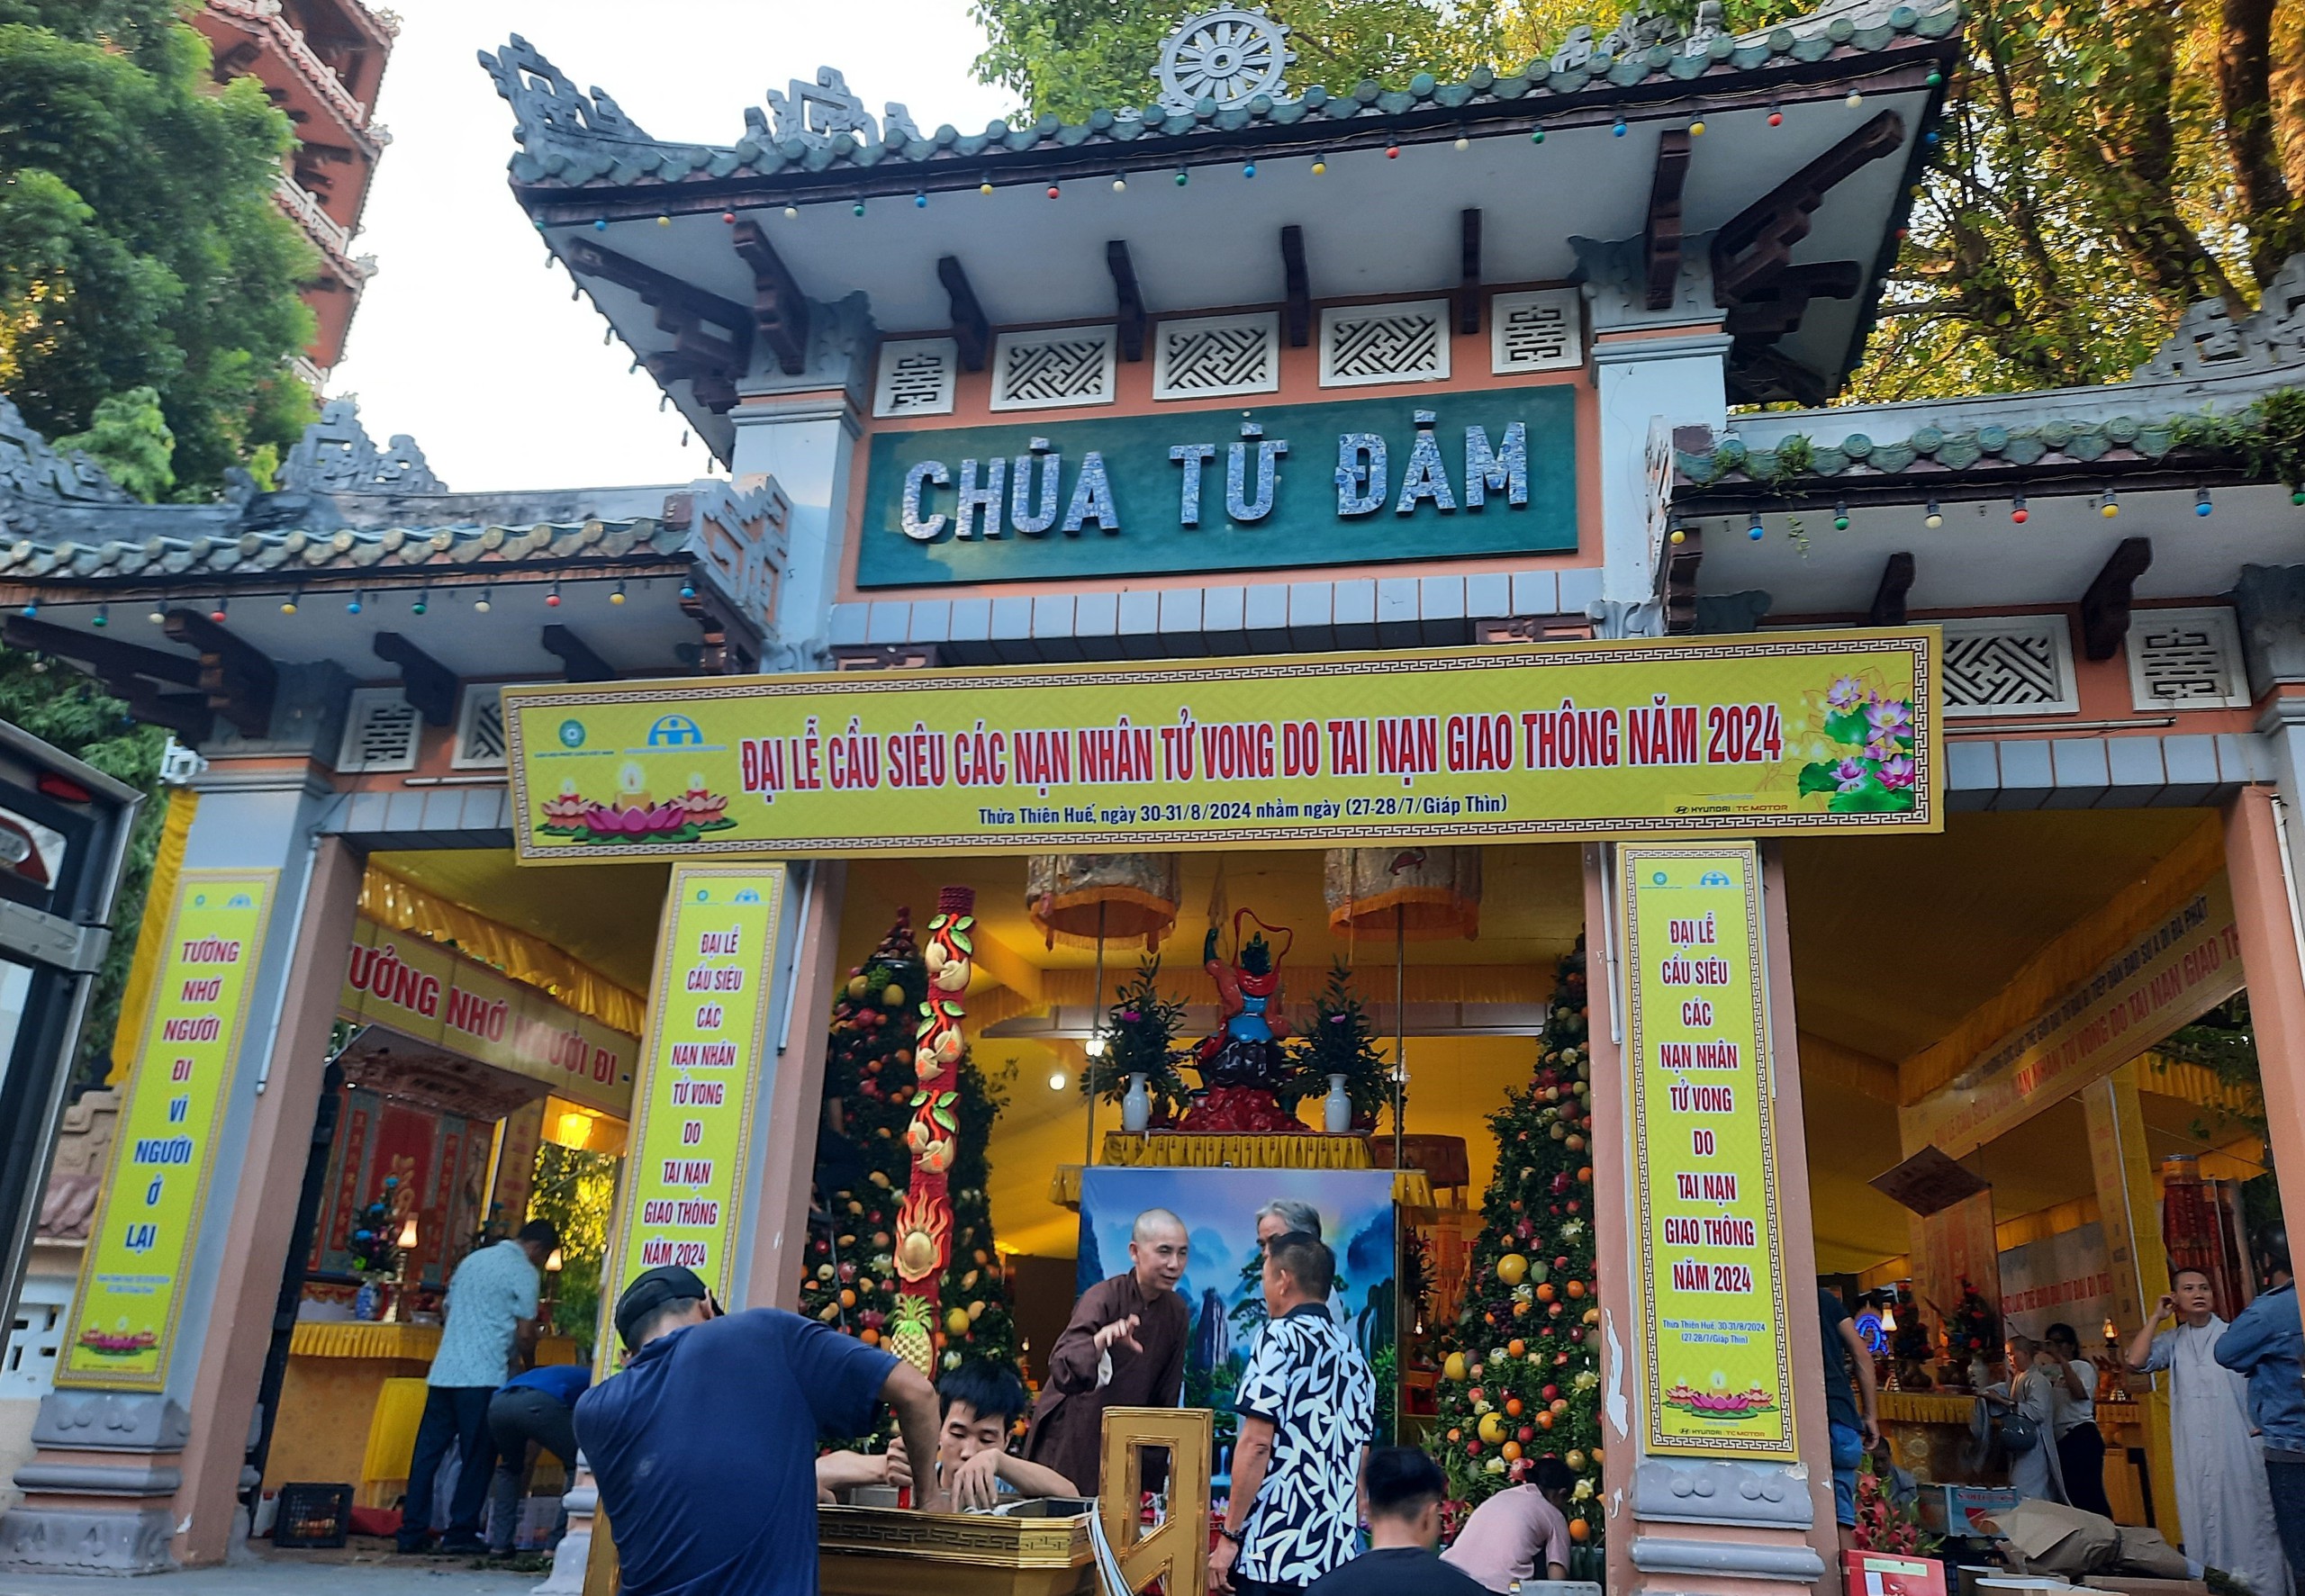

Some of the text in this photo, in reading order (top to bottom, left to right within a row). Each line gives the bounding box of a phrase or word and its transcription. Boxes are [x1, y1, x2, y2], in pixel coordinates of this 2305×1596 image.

[901, 409, 1528, 539] CHÙA TỪ ĐÀM
[742, 694, 1782, 803] ĐẠI LỄ CẦU SIÊU CÁC NẠN NHÂN TỬ VONG DO TAI NẠN GIAO THÔNG NĂM 2024
[979, 794, 1507, 825] Thừa Thiên Huế, ngày 30-31/8/2024 nhằm ngày (27-28/7/Giáp Thìn)
[701, 924, 739, 960] ĐẠI LỄ
[1671, 912, 1715, 949] ĐẠI LỄ
[181, 934, 240, 964] TƯỞNG
[2183, 936, 2222, 986] GIAO
[688, 964, 742, 992] CẦU SIÊU
[1662, 953, 1727, 984] CẦU SIÊU
[180, 978, 221, 1003] NHỚ
[697, 1001, 721, 1028] CÁC
[1683, 997, 1712, 1026] CÁC
[162, 1014, 220, 1042] NGƯỜI
[446, 986, 509, 1043] NHỚ
[592, 1047, 618, 1087] ĐI
[171, 1059, 191, 1083] ĐI
[672, 1041, 737, 1072] NẠN NHÂN
[1661, 1041, 1738, 1073] NẠN NHÂN
[673, 1076, 724, 1105] TỬ VONG
[1670, 1079, 1732, 1112] TỬ VONG
[168, 1094, 187, 1123] VÌ
[683, 1122, 701, 1144] DO
[1694, 1131, 1713, 1155] DO
[134, 1133, 193, 1165] NGƯỜI
[146, 1172, 162, 1208] Ở
[664, 1160, 711, 1190] TAI NẠN
[1677, 1174, 1736, 1205] TAI NẠN
[644, 1197, 719, 1225] GIAO THÔNG
[125, 1223, 158, 1255] LẠI
[1666, 1215, 1754, 1245] GIAO THÔNG
[643, 1238, 707, 1267] NĂM 2024
[1674, 1259, 1751, 1292] NĂM 2024
